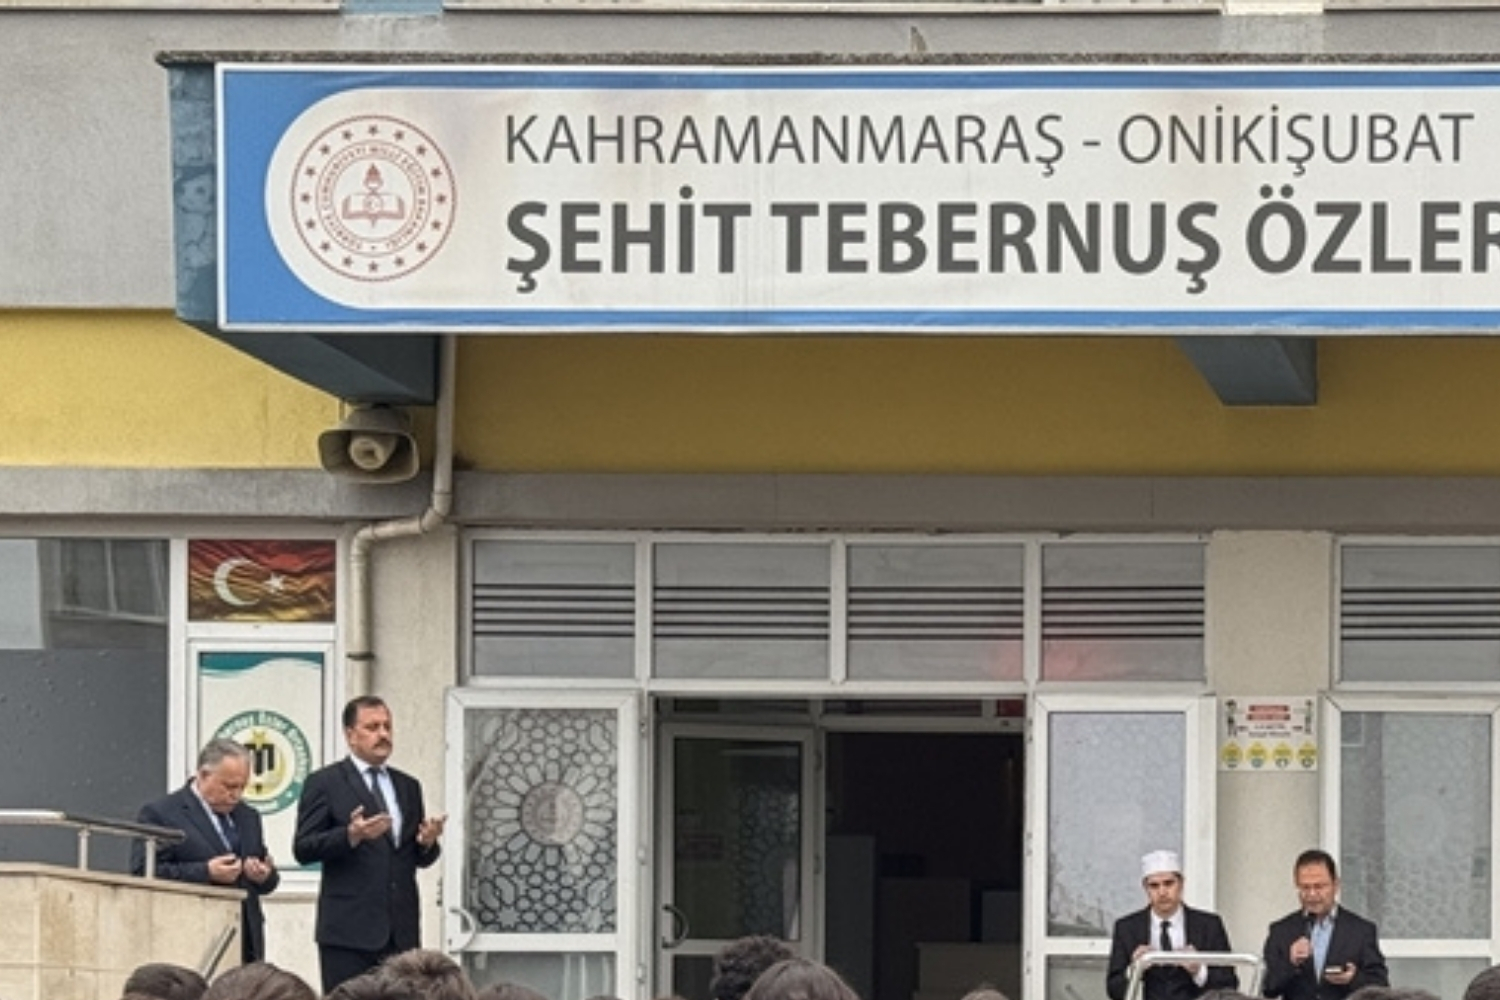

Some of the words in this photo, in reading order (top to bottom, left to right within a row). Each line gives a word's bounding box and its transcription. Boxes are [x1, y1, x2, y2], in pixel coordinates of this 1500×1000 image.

[506, 114, 1064, 177] KAHRAMANMARAŞ
[1118, 103, 1475, 176] ONİKİŞUBAT
[506, 185, 752, 294] ŞEHİT
[770, 200, 1221, 295] TEBERNUŞ
